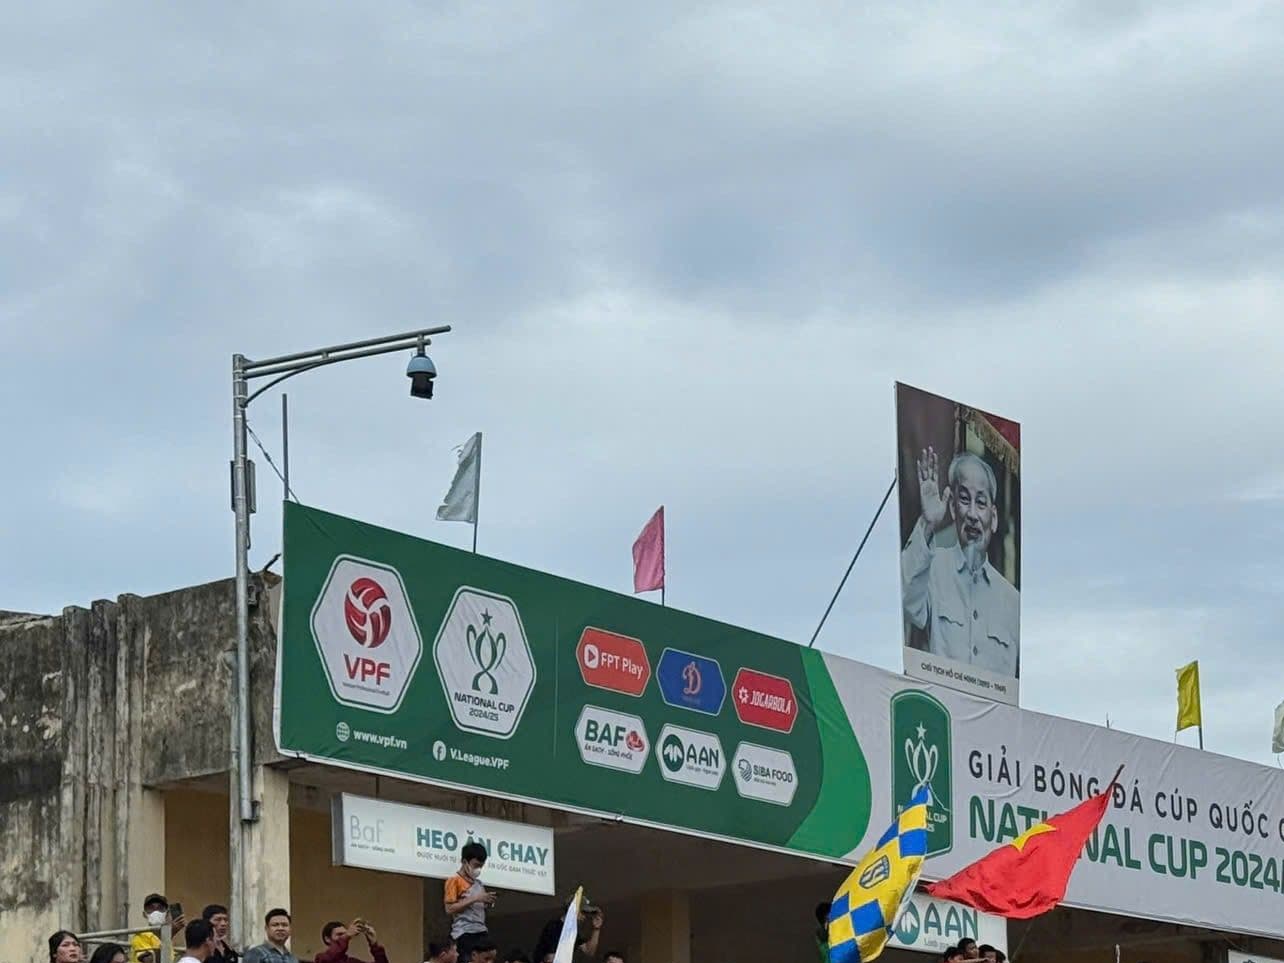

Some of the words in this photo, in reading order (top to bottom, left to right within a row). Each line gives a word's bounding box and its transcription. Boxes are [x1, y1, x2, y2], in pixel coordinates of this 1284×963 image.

[344, 654, 390, 685] VPF
[601, 652, 620, 668] FPT
[622, 657, 643, 679] Play
[454, 692, 497, 710] NATIONAL
[498, 703, 515, 713] CUP
[353, 730, 407, 749] www.vpf.vn
[585, 720, 626, 746] BAF
[450, 748, 510, 770] V.League.VPF
[753, 764, 771, 778] SIBA
[772, 766, 793, 783] FOOD
[969, 745, 1021, 787] GIẢI
[1034, 761, 1100, 802] BÓNG
[1112, 780, 1143, 814] ĐÁ
[1156, 781, 1197, 822] CÚP
[1210, 800, 1269, 838] QUỐC
[416, 827, 458, 851] HEO
[497, 841, 549, 866] CHAY
[969, 795, 1141, 870] NATNAL
[1148, 832, 1208, 879] CUP
